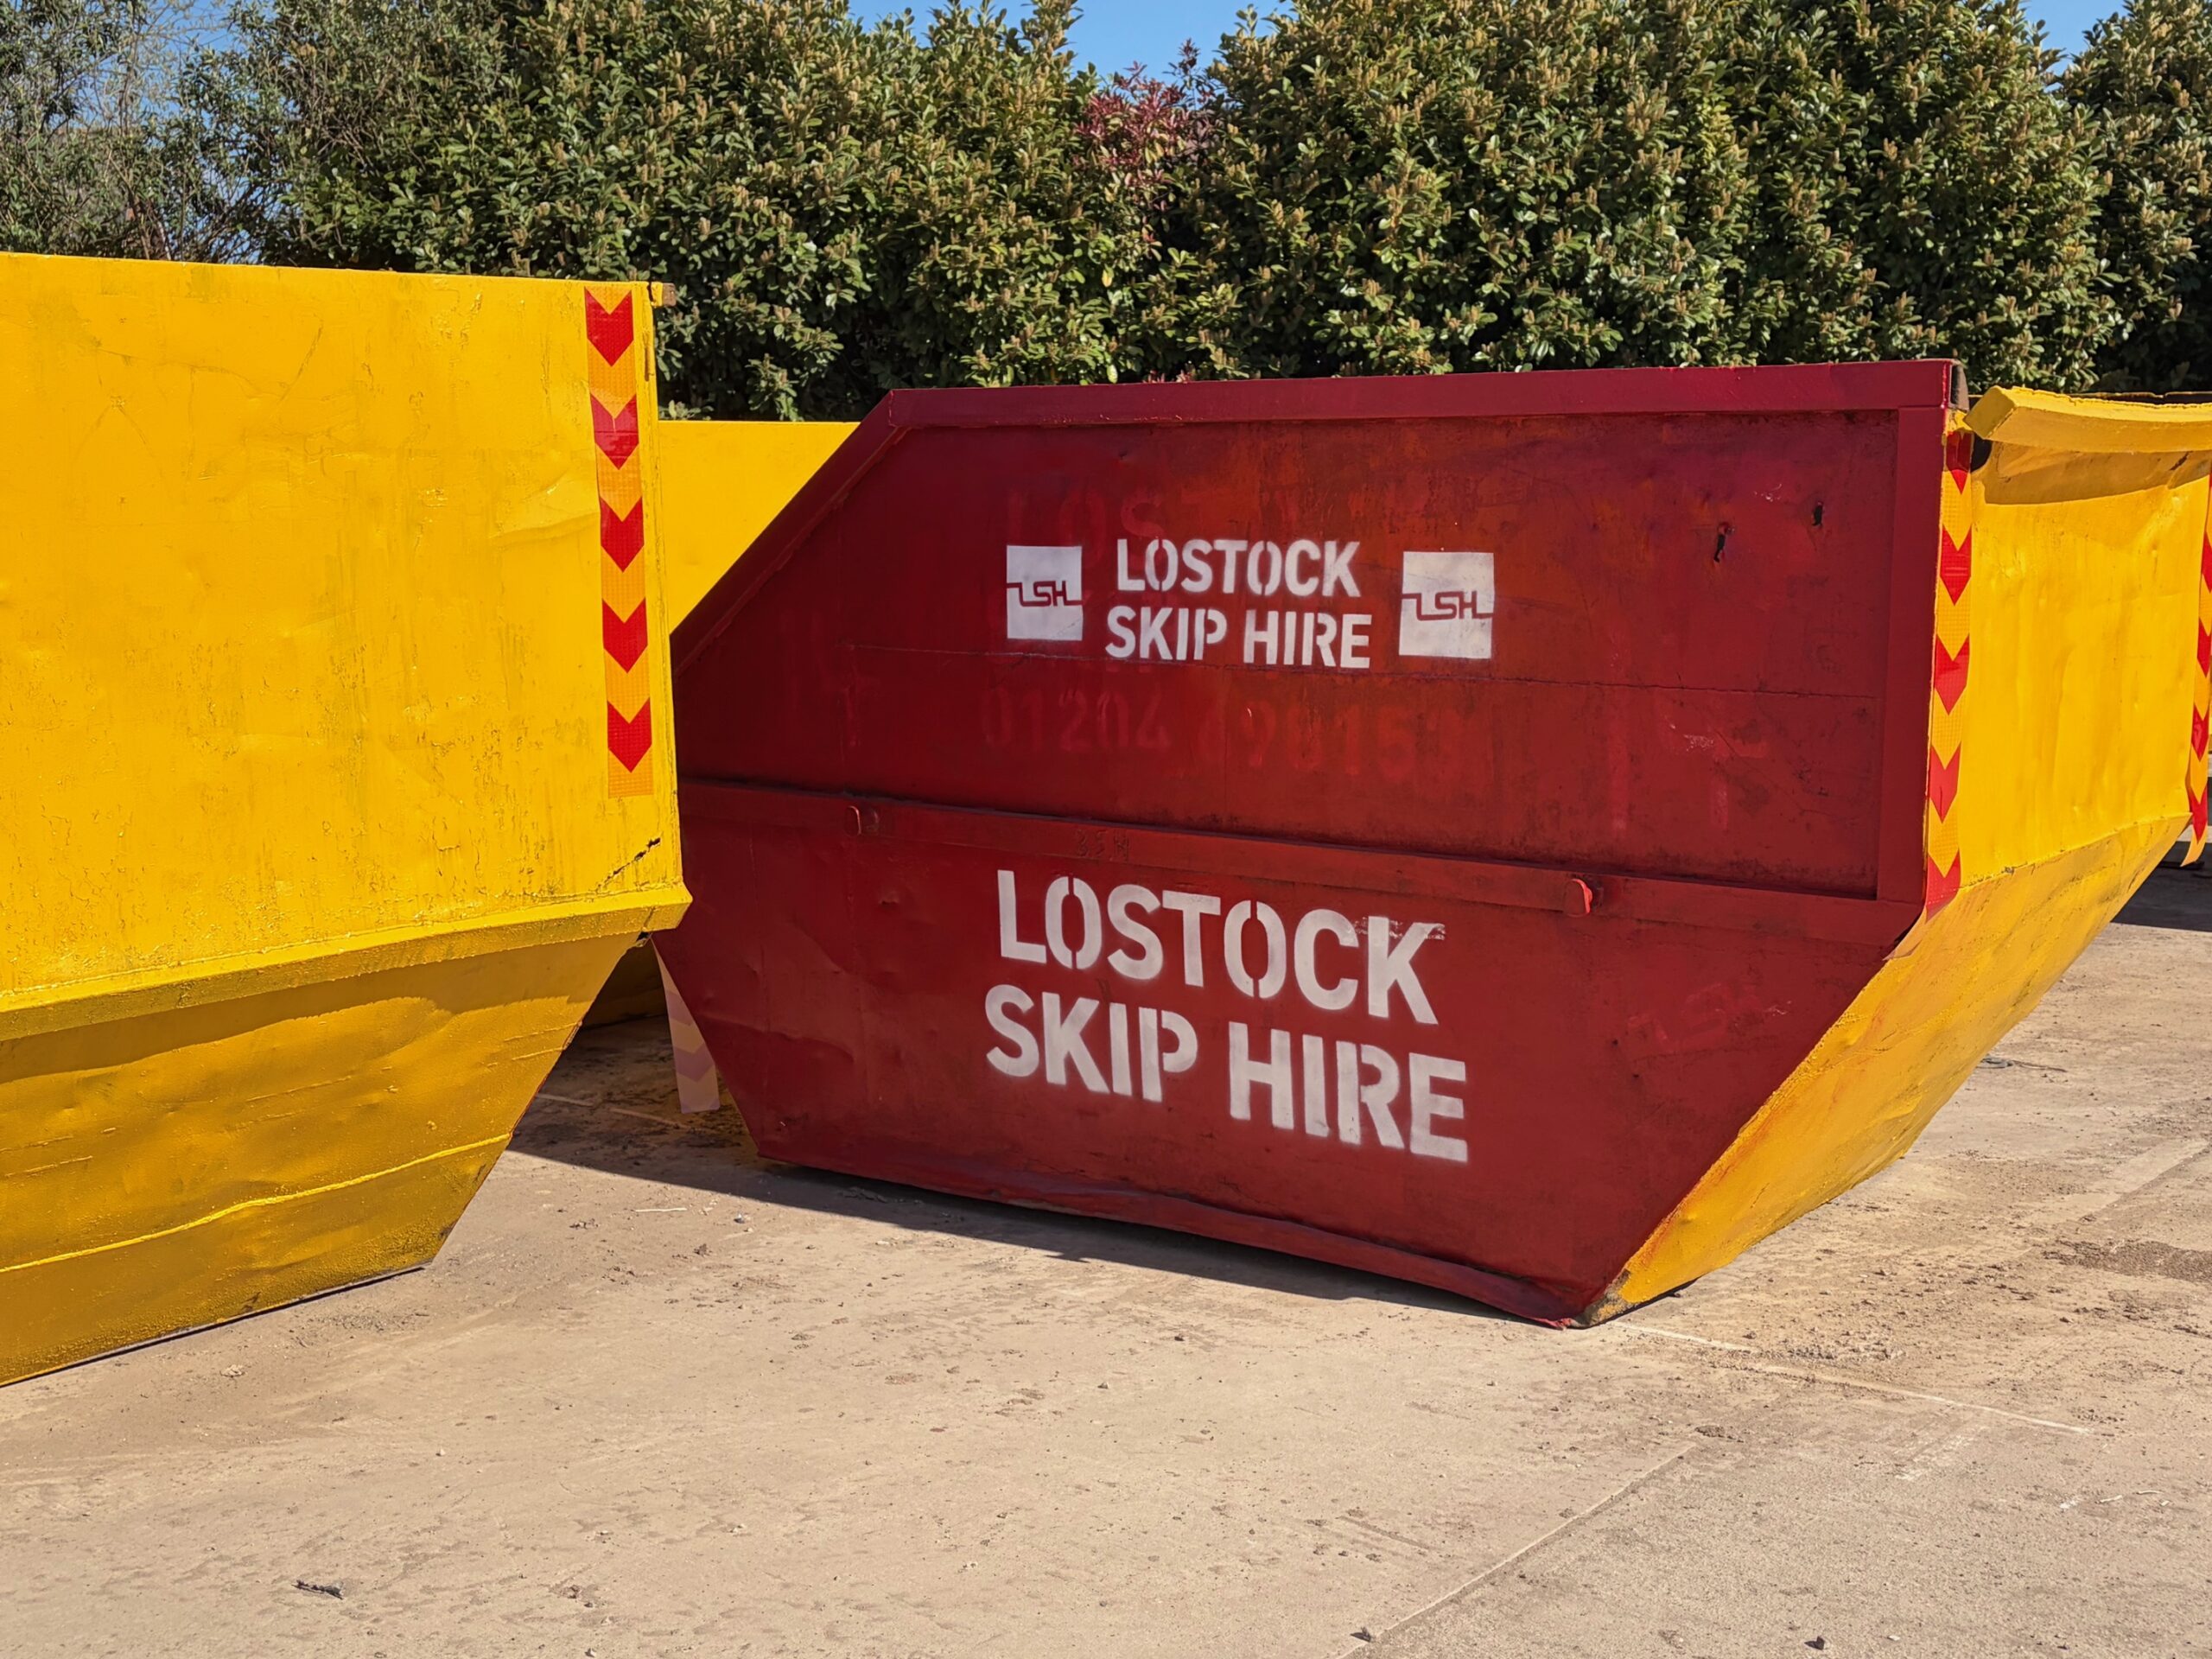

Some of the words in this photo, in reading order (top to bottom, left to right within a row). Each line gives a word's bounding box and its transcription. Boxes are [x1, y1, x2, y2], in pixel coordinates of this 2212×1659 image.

[1014, 581, 1077, 607] LSH
[1117, 538, 1361, 598] LOSTOCK
[1410, 591, 1486, 620] LSH
[1105, 606, 1227, 661] SKIP
[1243, 609, 1372, 669] HIRE
[998, 870, 1446, 1025] LOSTOCK
[985, 984, 1198, 1103] SKIP
[1229, 1021, 1468, 1164] HIRE
